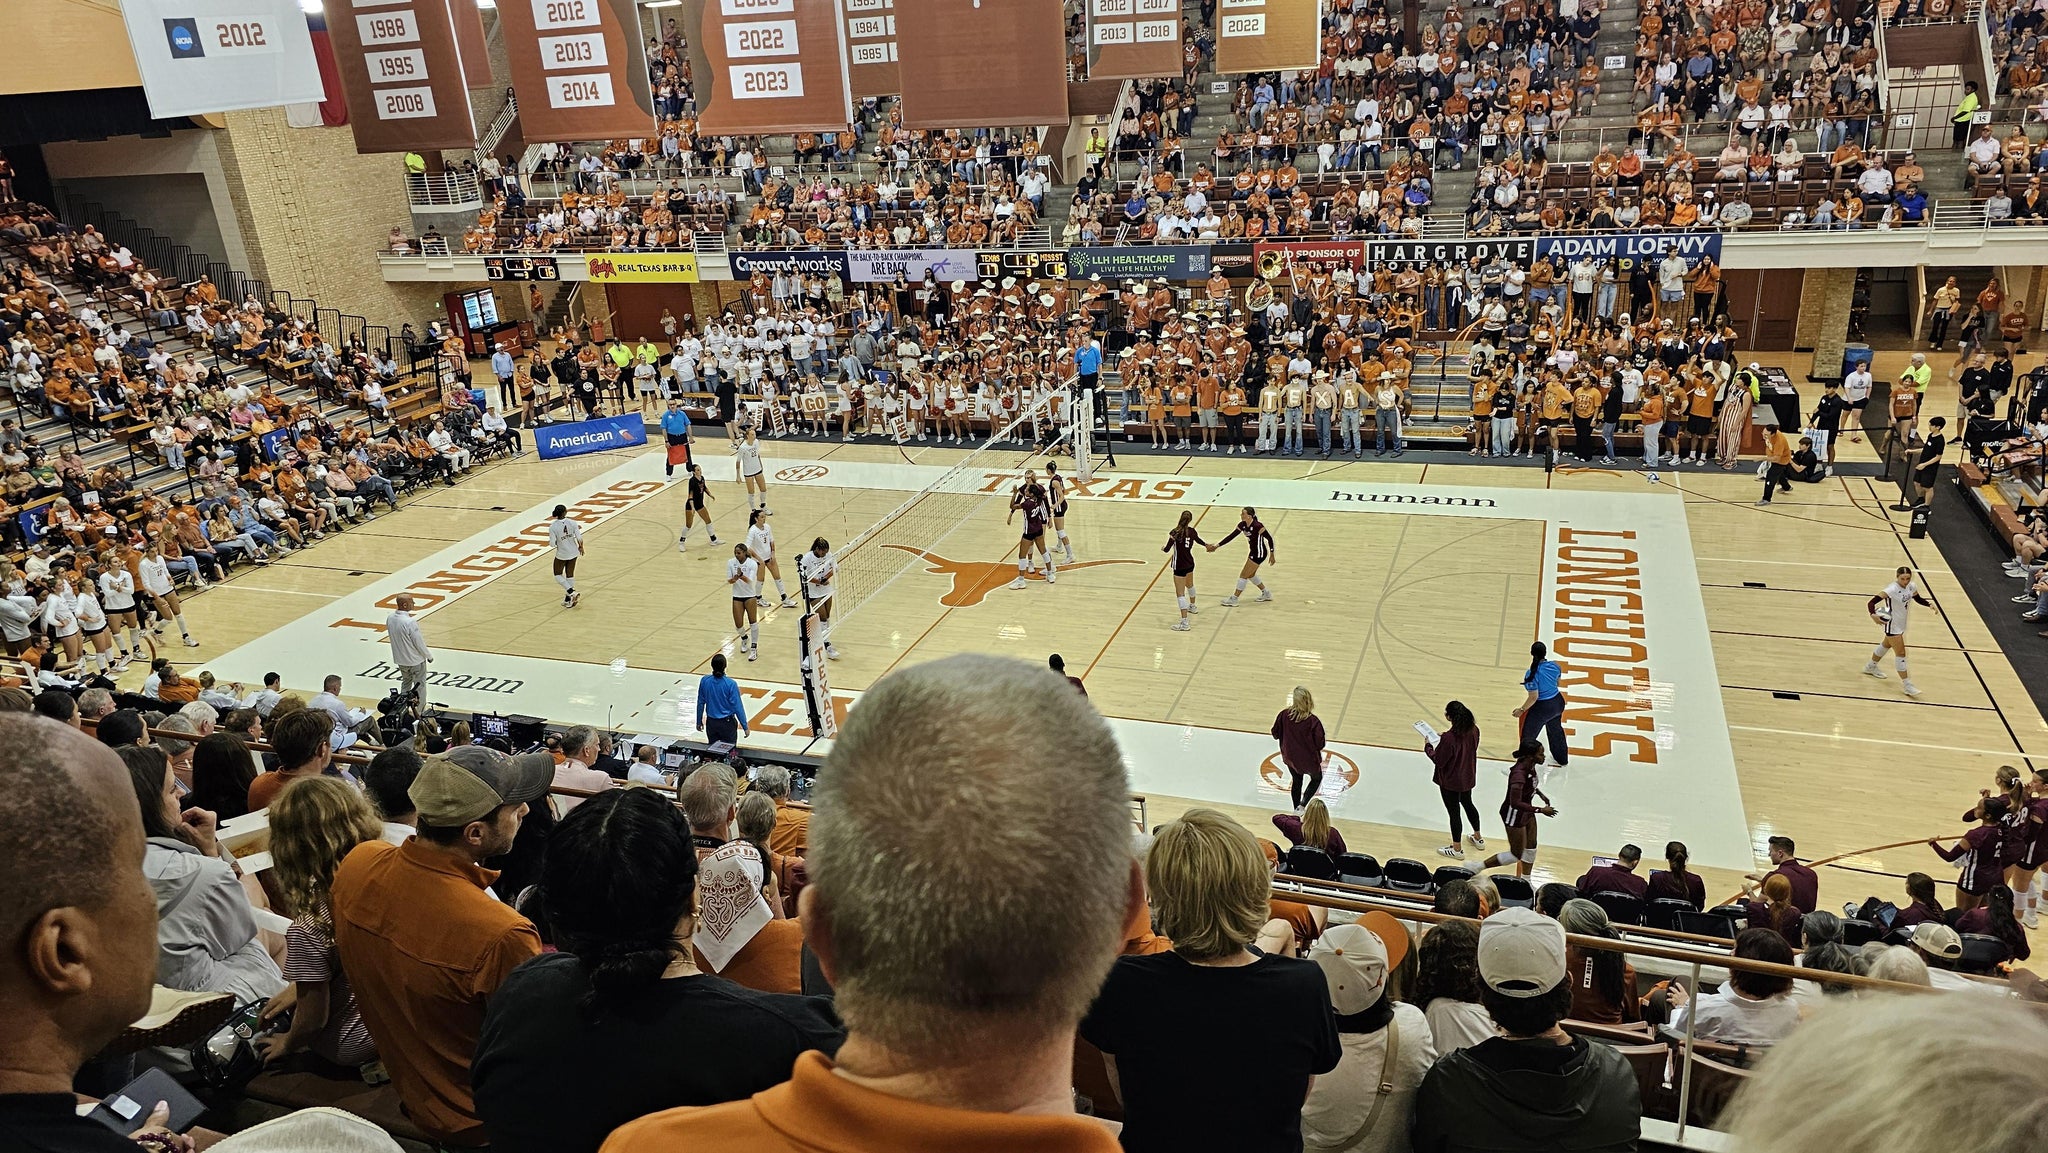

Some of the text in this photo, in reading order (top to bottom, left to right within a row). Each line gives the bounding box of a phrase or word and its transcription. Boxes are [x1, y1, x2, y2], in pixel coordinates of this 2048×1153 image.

[547, 1, 586, 23] 2012
[216, 22, 266, 47] 2012
[370, 18, 406, 39] 1988
[855, 21, 879, 34] 1984
[1100, 27, 1127, 40] 2013
[1143, 25, 1170, 38] 2018
[1228, 19, 1259, 33] 2022
[738, 28, 785, 50] 2022
[554, 41, 592, 63] 2013
[858, 48, 882, 61] 1985
[379, 56, 415, 77] 1995
[744, 70, 789, 93] 2023
[562, 81, 600, 102] 2014
[386, 93, 425, 114] 2008
[1296, 249, 1344, 258] SPONSOR
[1346, 248, 1361, 257] OF
[1374, 243, 1528, 260] HARGROVE
[1549, 235, 1711, 256] ADAM LOEWY
[736, 255, 842, 272] Groundworks
[860, 252, 893, 261] BACK-TO-BACK
[981, 254, 1000, 262] TEXAS
[1092, 254, 1176, 265] LLH HEALTHCARE
[618, 264, 636, 272] REAL
[637, 264, 661, 272] TEXAS
[871, 262, 887, 275] ARE
[1026, 267, 1032, 277] 3
[804, 396, 826, 411] GO
[771, 400, 785, 433] POINT
[894, 417, 910, 440] ARE
[549, 429, 613, 449] American
[977, 473, 1193, 500] TXAS
[1329, 489, 1498, 508] humann
[1184, 537, 1191, 548] 5
[1553, 527, 1658, 764] LONGHORNS
[814, 646, 832, 730] TEXAS
